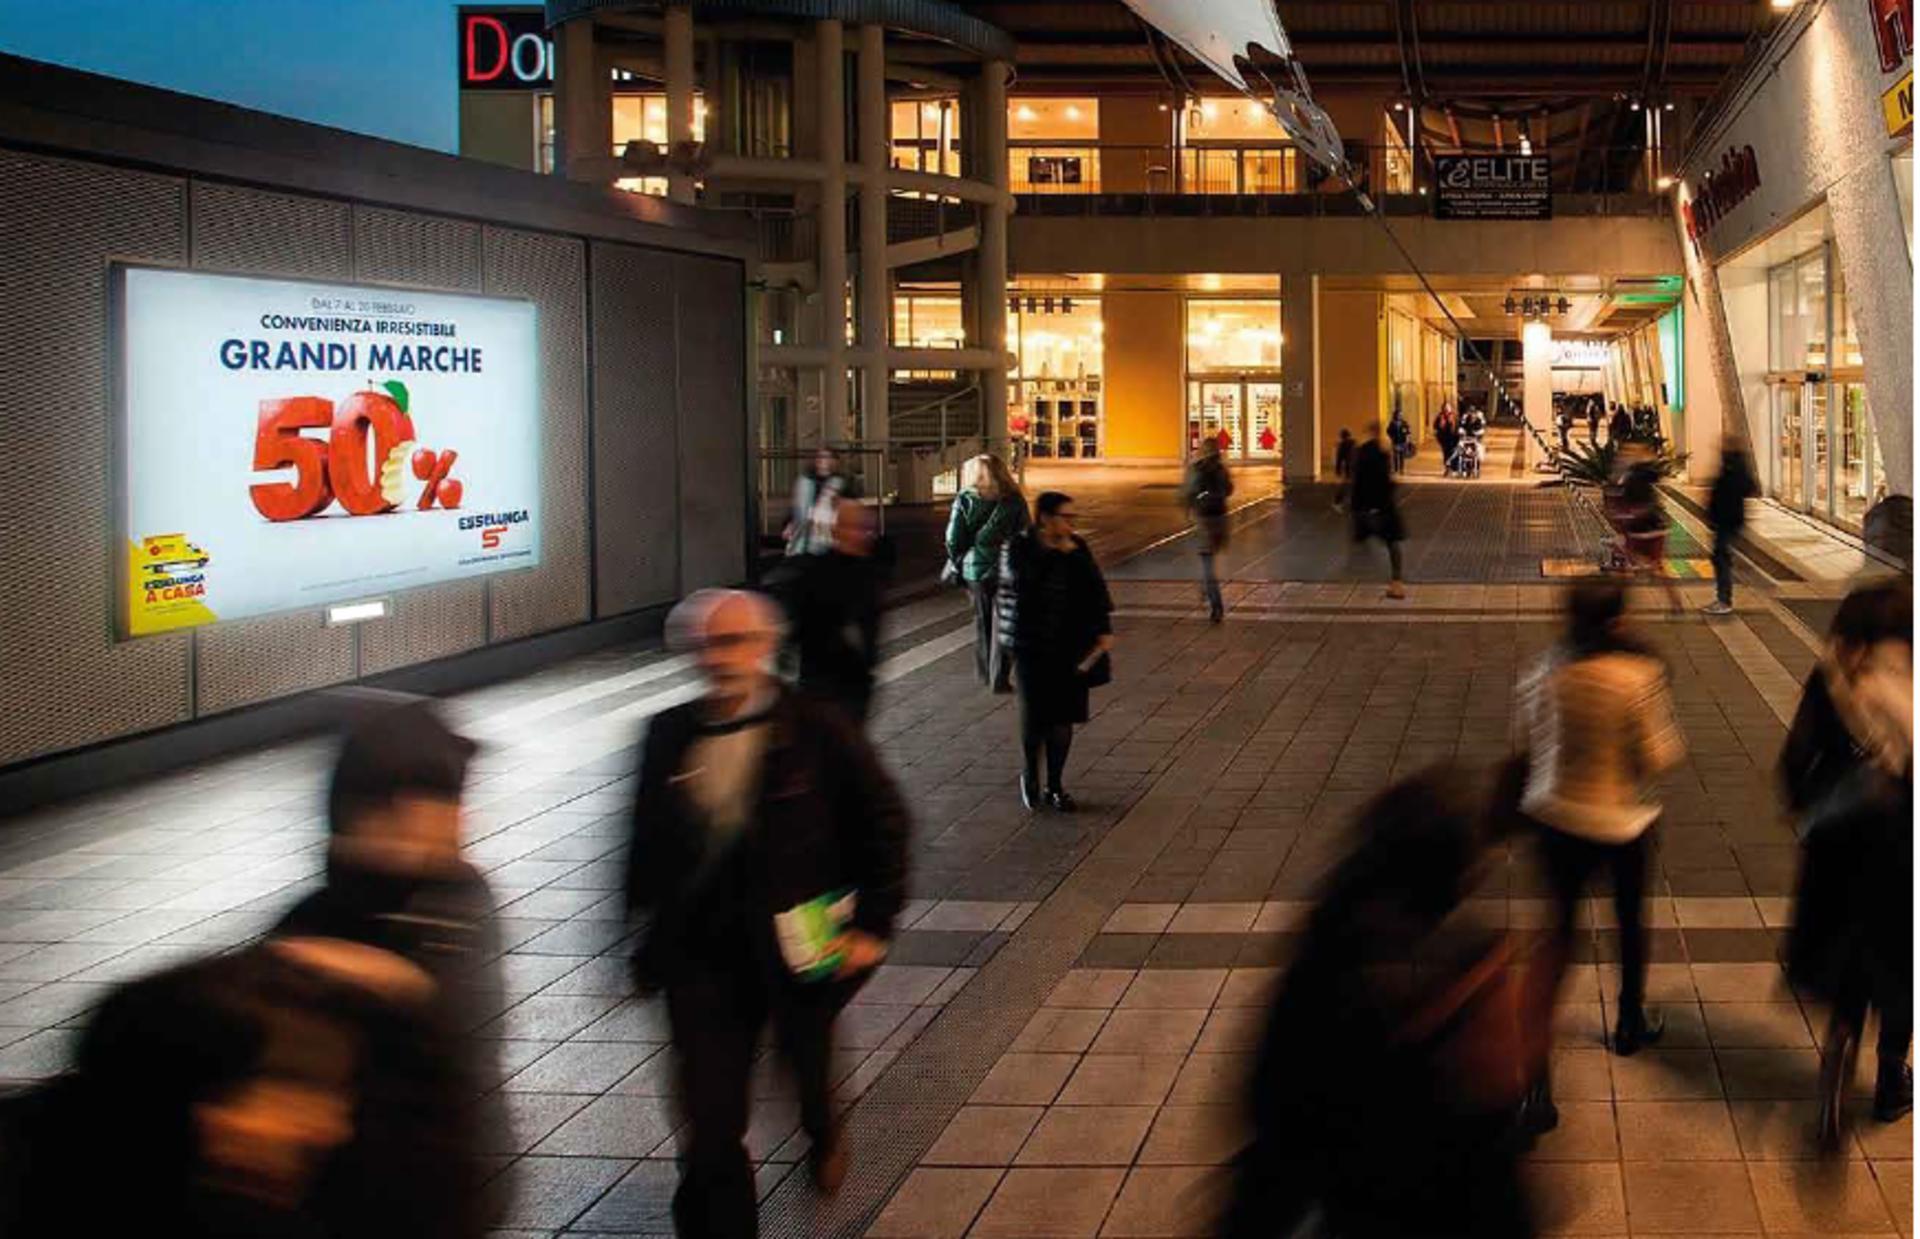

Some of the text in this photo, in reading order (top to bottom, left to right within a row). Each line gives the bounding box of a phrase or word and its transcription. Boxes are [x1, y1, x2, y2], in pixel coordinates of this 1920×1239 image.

[1473, 158, 1548, 181] ELITE
[311, 297, 332, 309] DAL
[333, 299, 341, 310] 7
[344, 300, 355, 311] AL
[260, 314, 456, 338] CONVENIENZA IRRESISTIBILE
[219, 338, 482, 373] GRANDI MARCHE
[458, 510, 529, 530] ESSELUNGA
[162, 583, 206, 601] CASA
